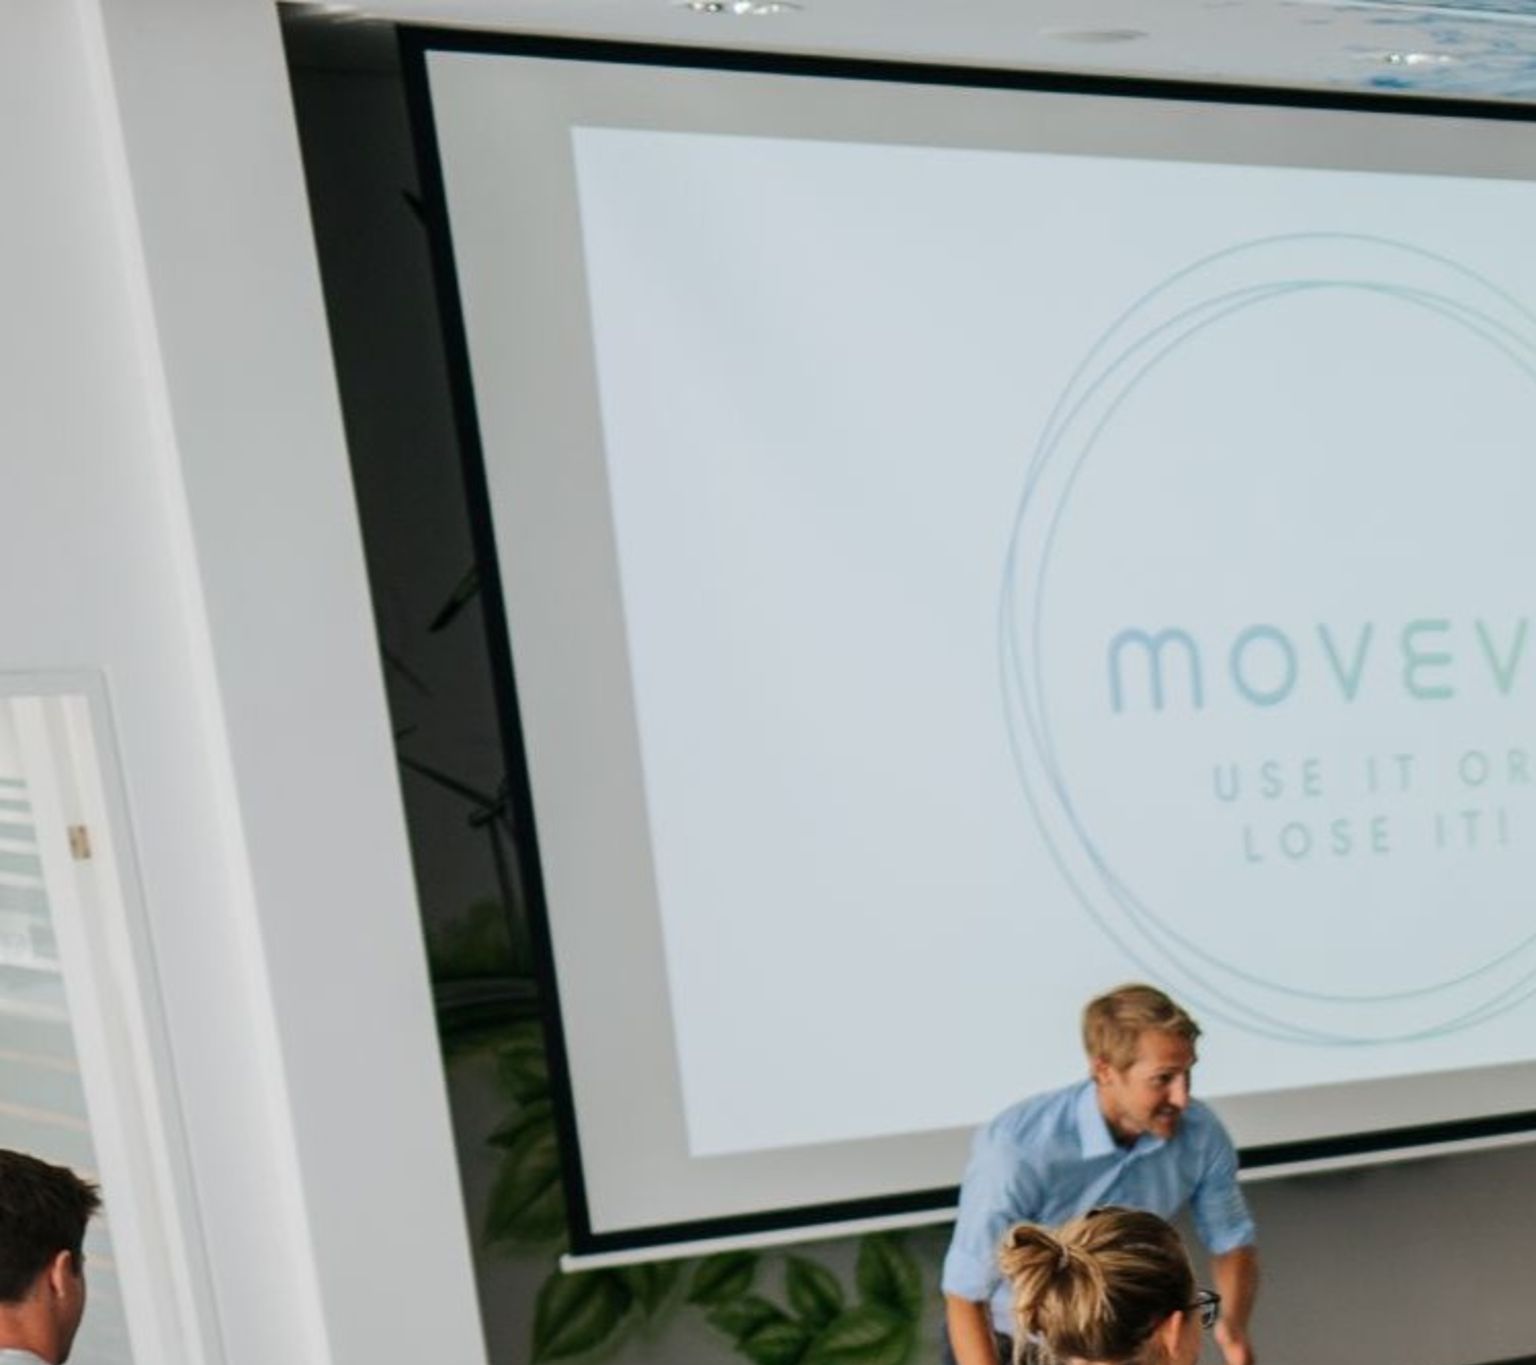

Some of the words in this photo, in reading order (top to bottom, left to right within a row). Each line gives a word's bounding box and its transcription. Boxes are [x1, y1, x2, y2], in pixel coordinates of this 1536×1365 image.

[1212, 757, 1324, 803] USE
[1366, 753, 1415, 793] IT
[1457, 748, 1531, 788] OR
[1243, 816, 1391, 864] LOSE
[1433, 807, 1510, 849] IT!
